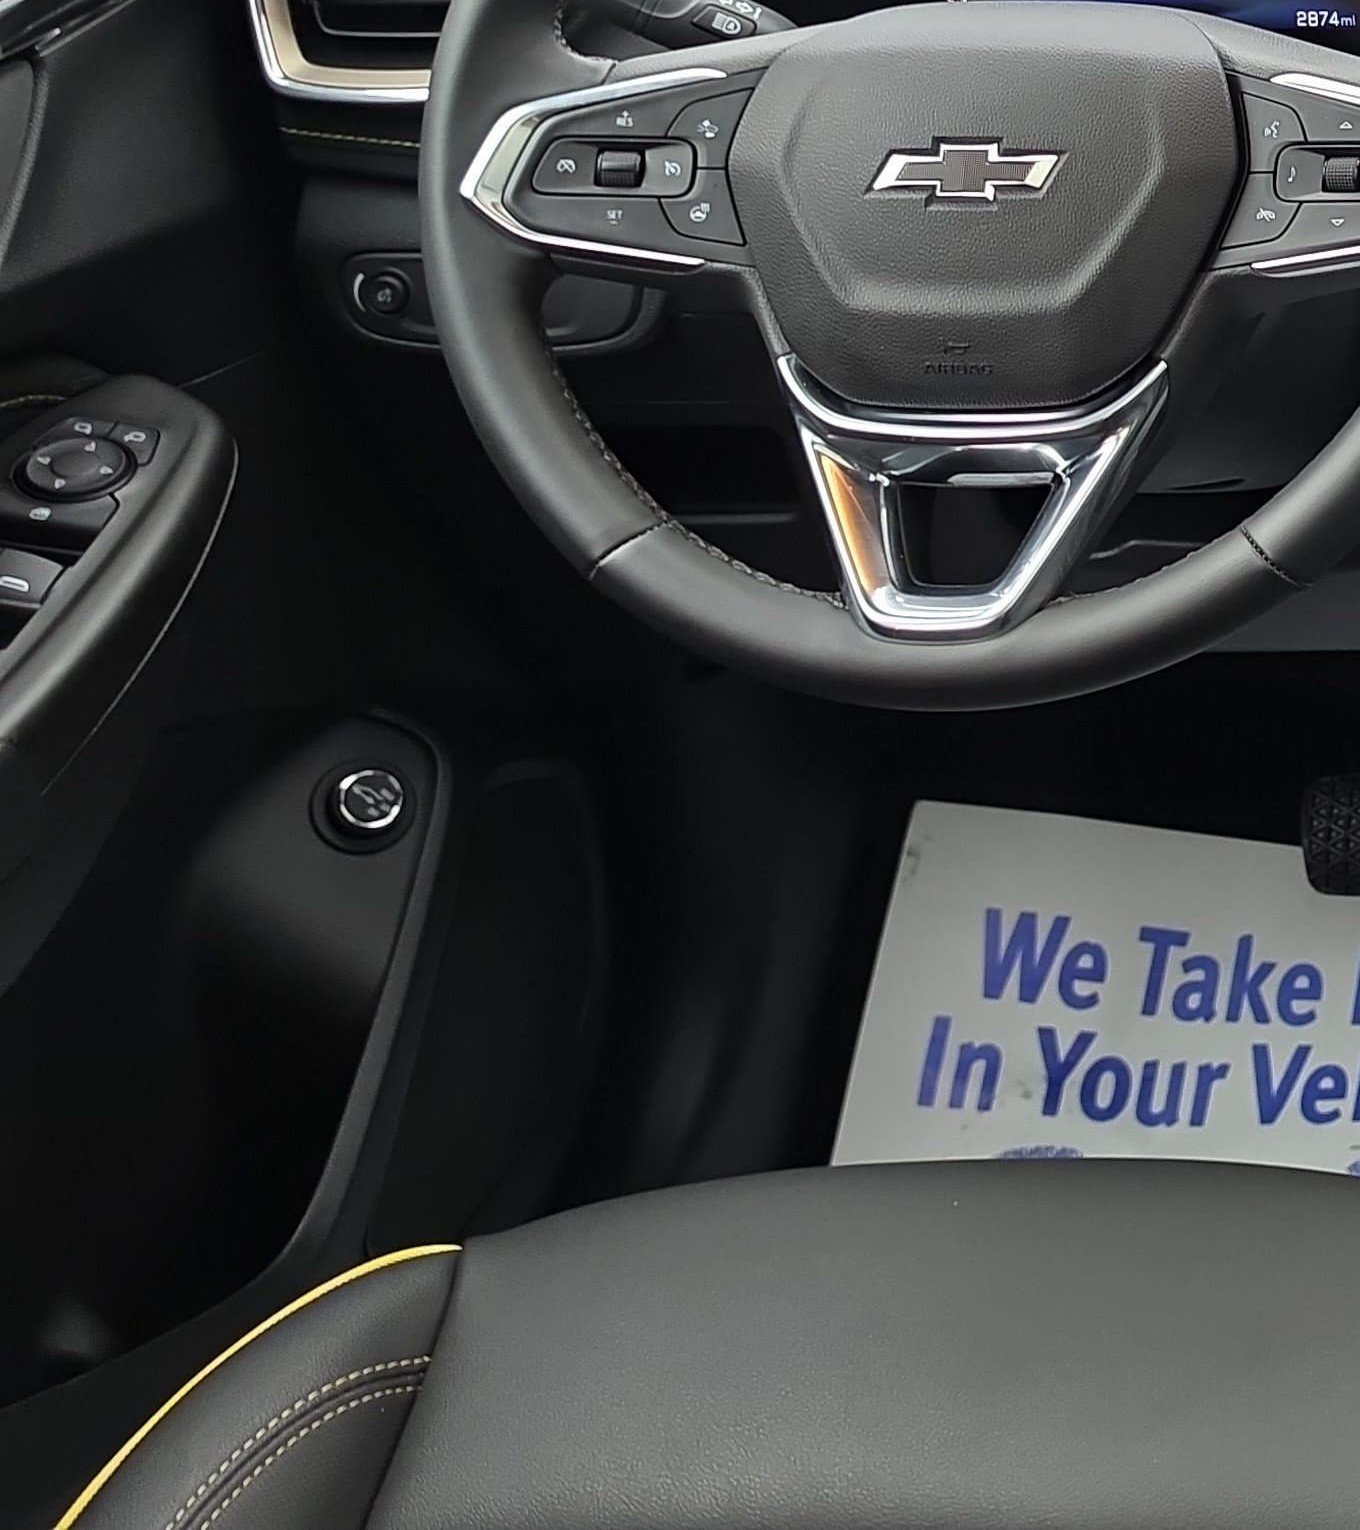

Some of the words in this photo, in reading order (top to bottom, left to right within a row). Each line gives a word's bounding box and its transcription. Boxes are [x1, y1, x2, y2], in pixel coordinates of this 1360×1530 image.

[607, 210, 623, 219] SET
[982, 906, 1108, 1010] We
[1139, 925, 1324, 1027] Take
[916, 1014, 1002, 1112] In
[1035, 1025, 1231, 1128] Your
